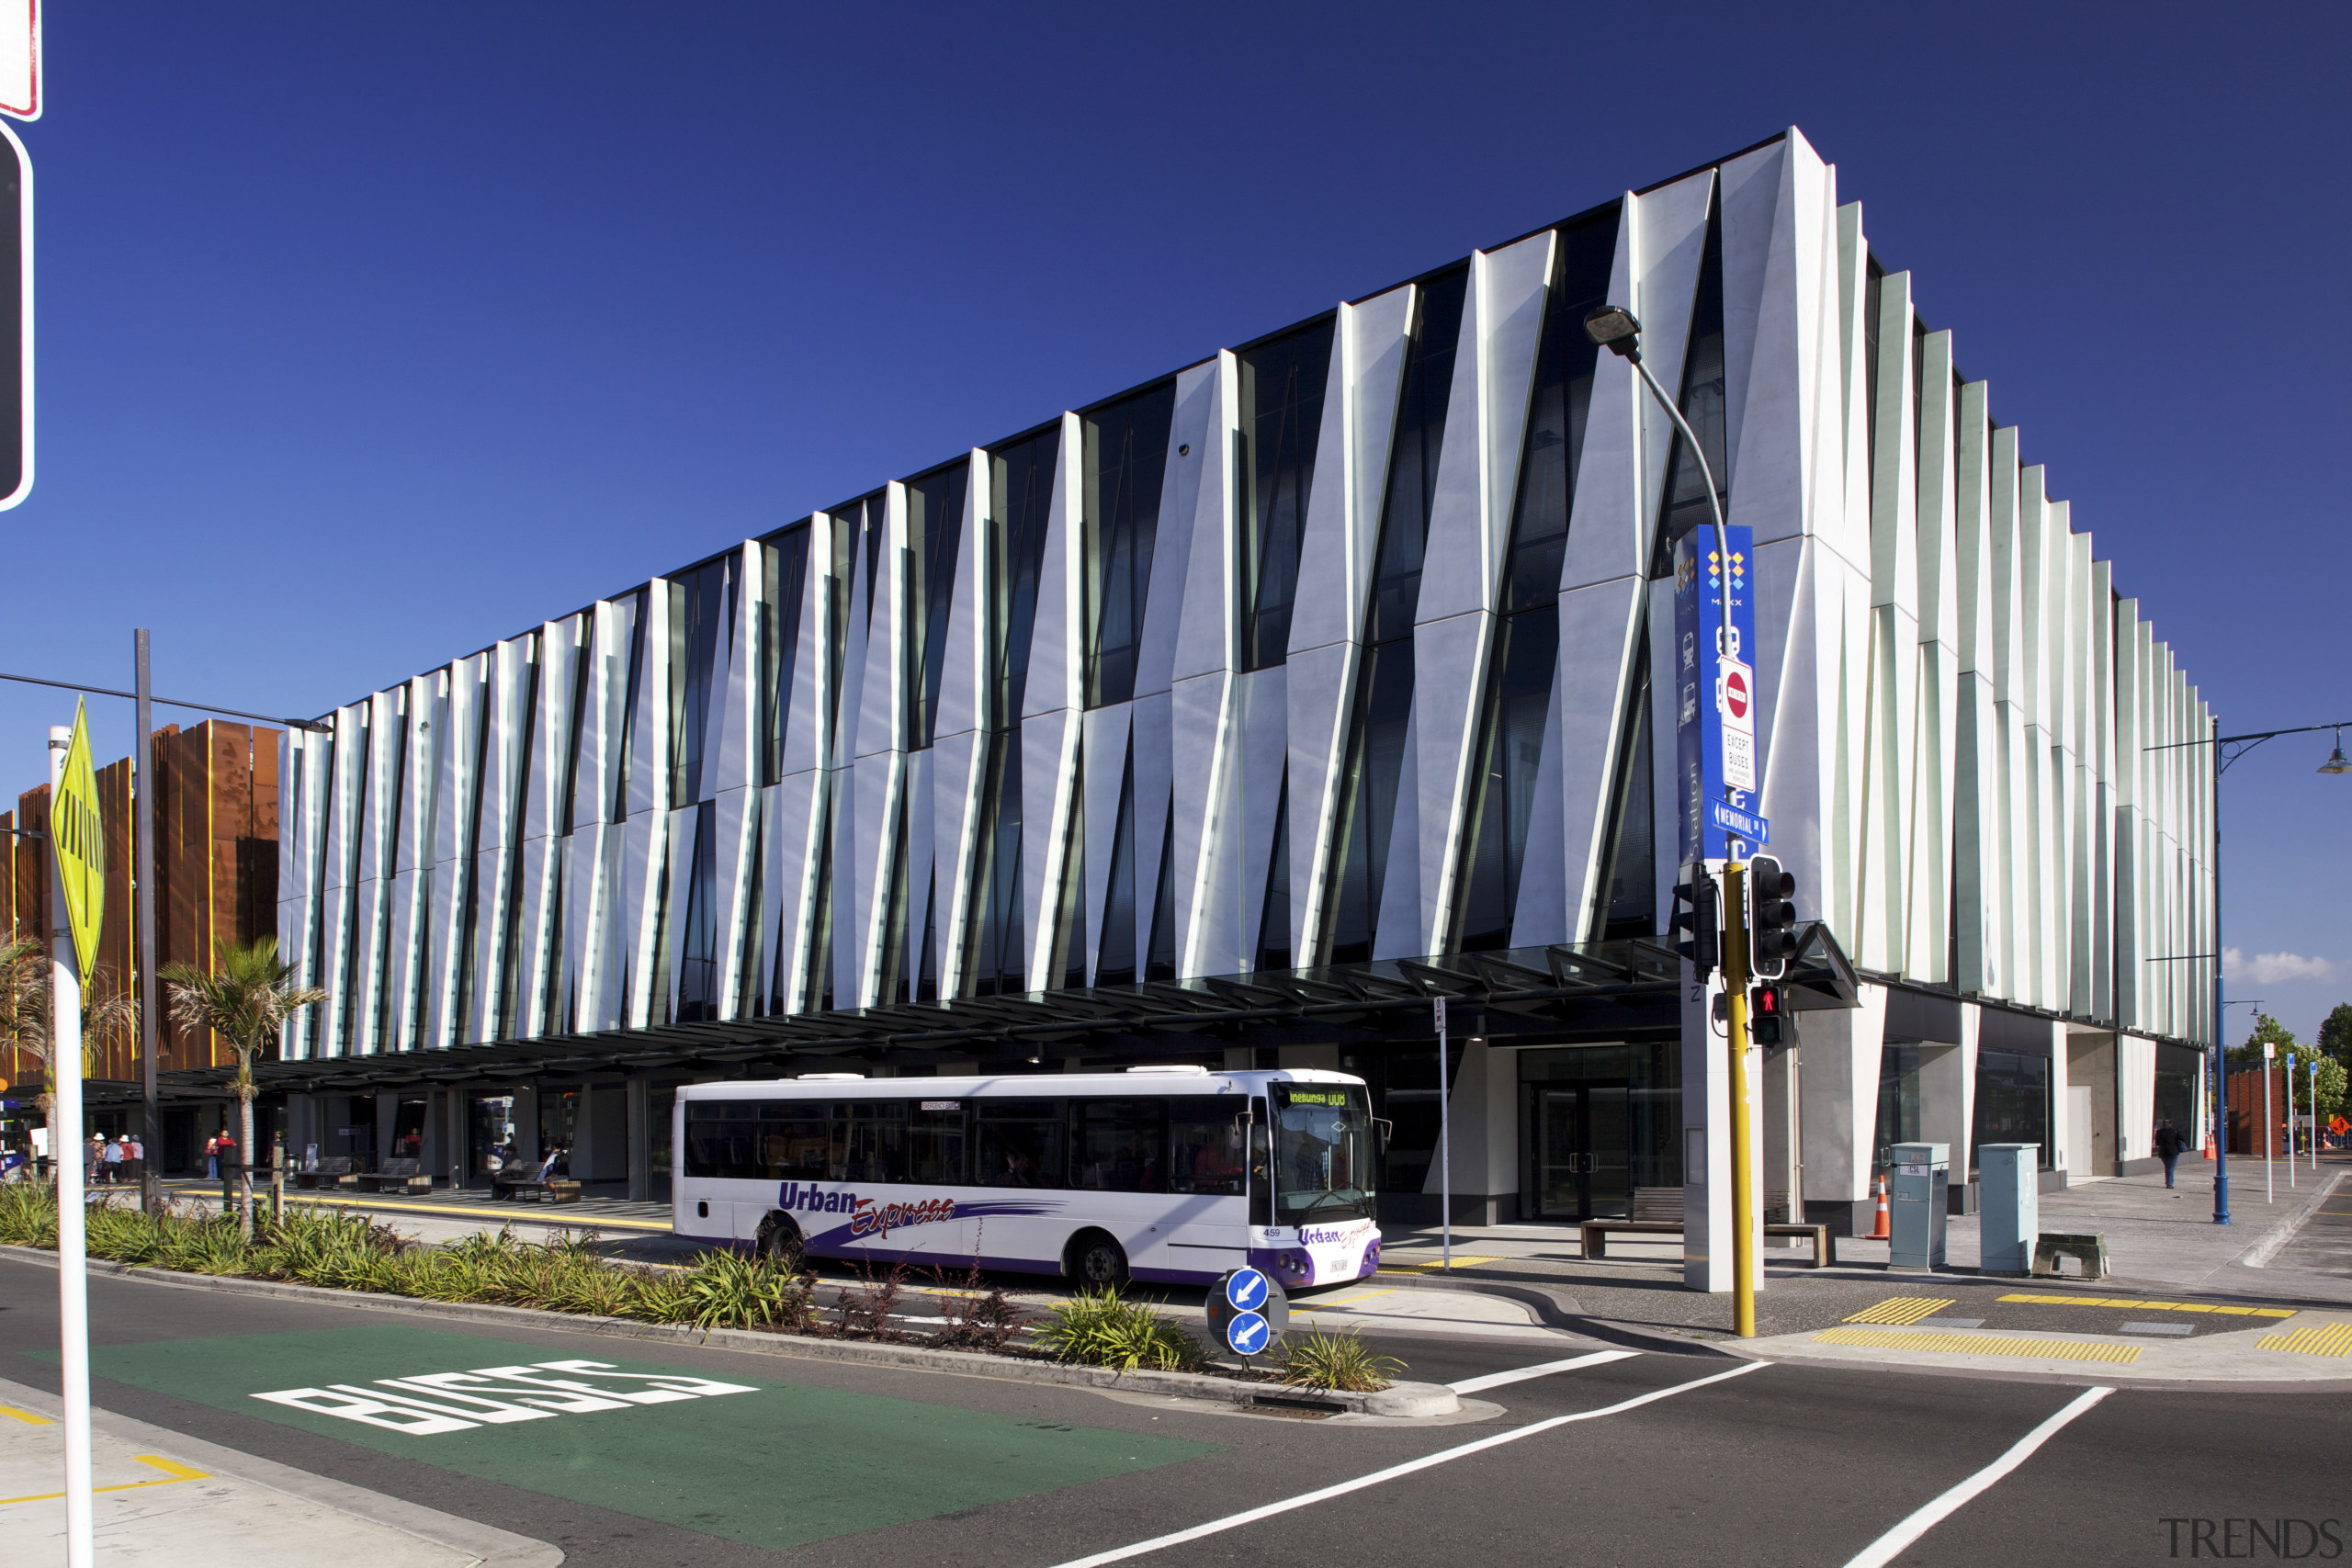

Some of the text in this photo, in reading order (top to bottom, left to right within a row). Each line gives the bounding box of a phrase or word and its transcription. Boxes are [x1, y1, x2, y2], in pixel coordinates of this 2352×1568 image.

[1711, 598, 1742, 606] MXX
[1727, 734, 1749, 752] EXCEPT
[1729, 751, 1749, 770] BUSES
[1690, 761, 1699, 857] Station
[1720, 807, 1759, 835] MEMORIAL DR
[779, 1182, 955, 1240] Urban Express
[1263, 1228, 1281, 1237] 459
[1298, 1227, 1341, 1246] Urban
[247, 1359, 762, 1436] BUSES
